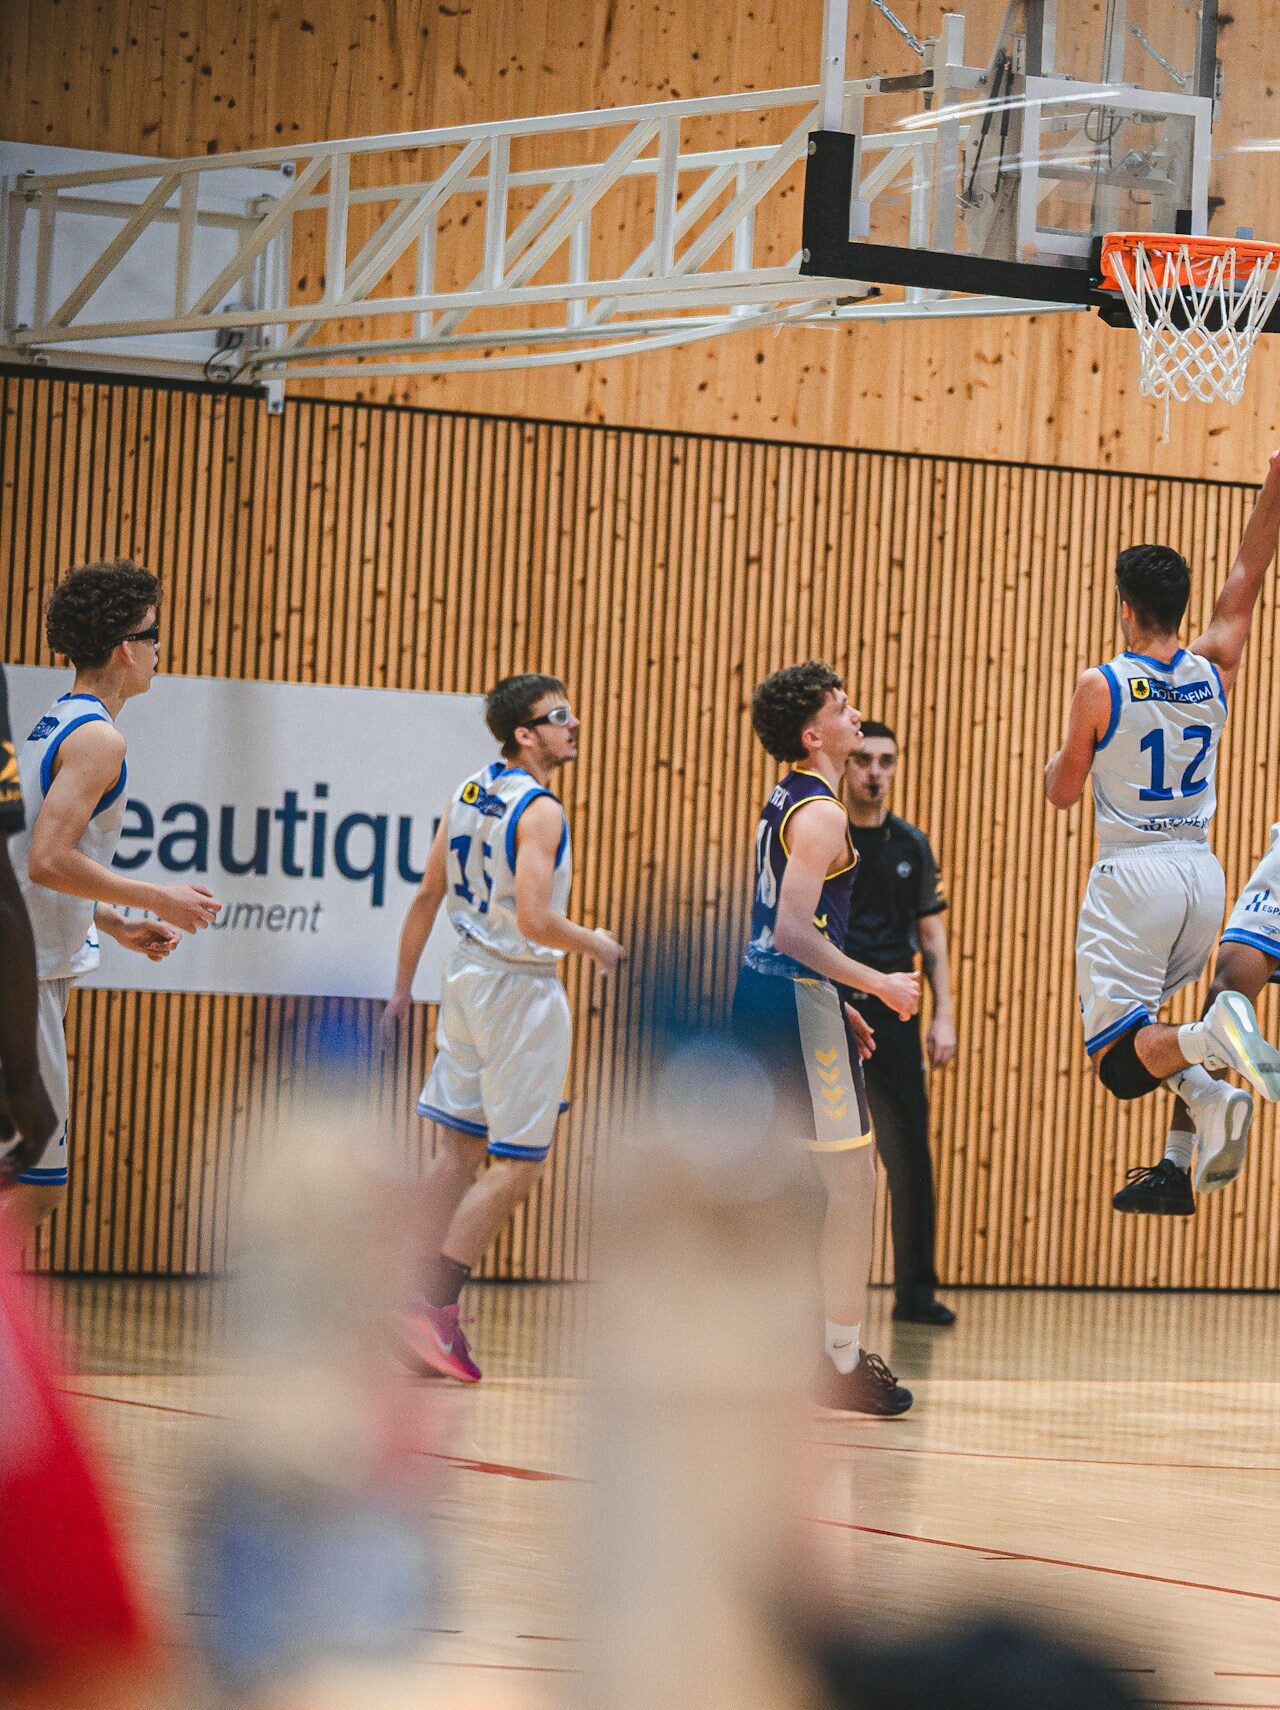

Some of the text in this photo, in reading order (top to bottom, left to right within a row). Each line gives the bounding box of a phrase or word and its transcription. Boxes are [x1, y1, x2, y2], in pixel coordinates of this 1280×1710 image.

[1139, 725, 1212, 801] 12
[111, 782, 441, 908] eautiqu
[211, 901, 323, 934] ument
